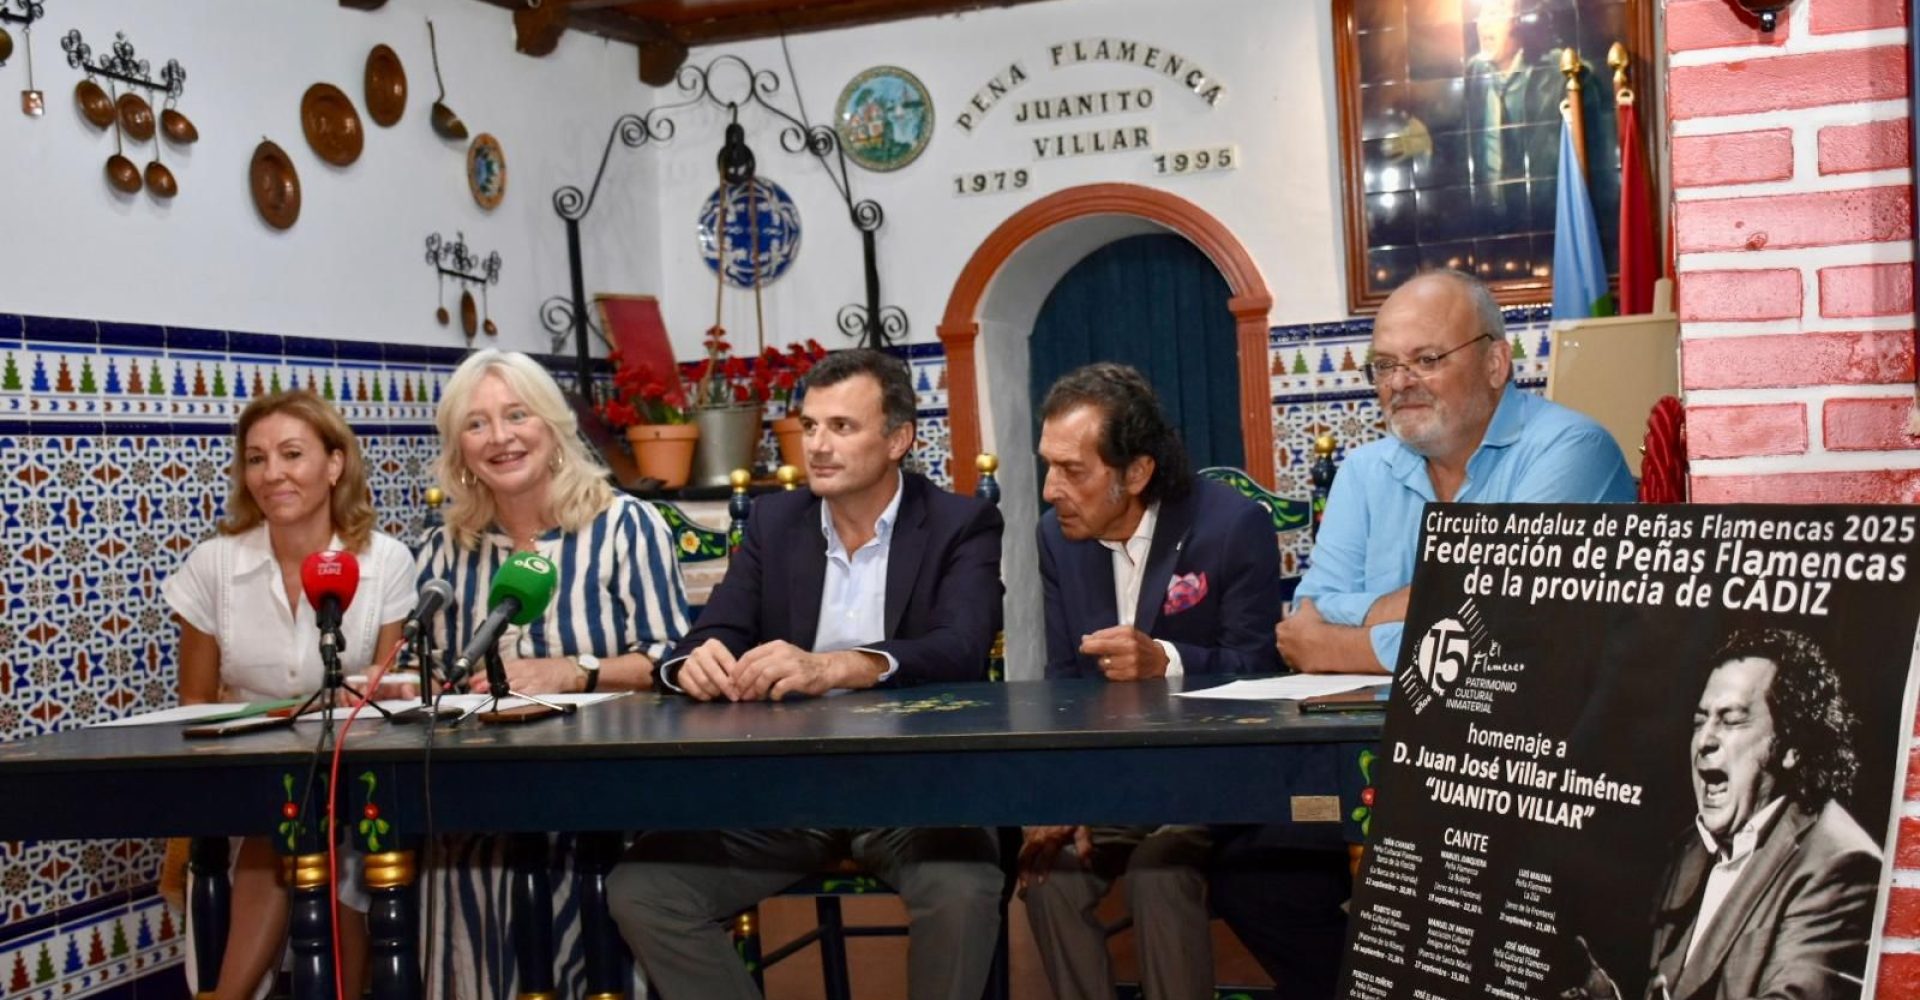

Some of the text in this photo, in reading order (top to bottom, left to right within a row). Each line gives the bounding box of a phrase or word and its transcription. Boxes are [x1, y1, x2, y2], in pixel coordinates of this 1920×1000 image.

[1051, 40, 1222, 107] FLAMENCA
[1016, 89, 1153, 122] JUANITO
[1033, 127, 1150, 157] VILLAR
[955, 149, 1231, 194] 1979 1995
[1427, 511, 1915, 543] Circuito Andaluz de Peñas Flamencas 2025
[1424, 535, 1906, 581] Federación de Peñas Flamencas
[1464, 566, 1831, 615] de la provincia de CÁDIZ
[1426, 628, 1470, 690] 15
[1455, 688, 1494, 702] CULTURAL
[1466, 677, 1517, 693] PATRIMONIO
[1446, 699, 1492, 713] INMATERIAL
[1468, 723, 1566, 759] homenaje a
[1393, 742, 1642, 805] D. Juan José Villar Jiménez
[1445, 828, 1488, 852] CANTE
